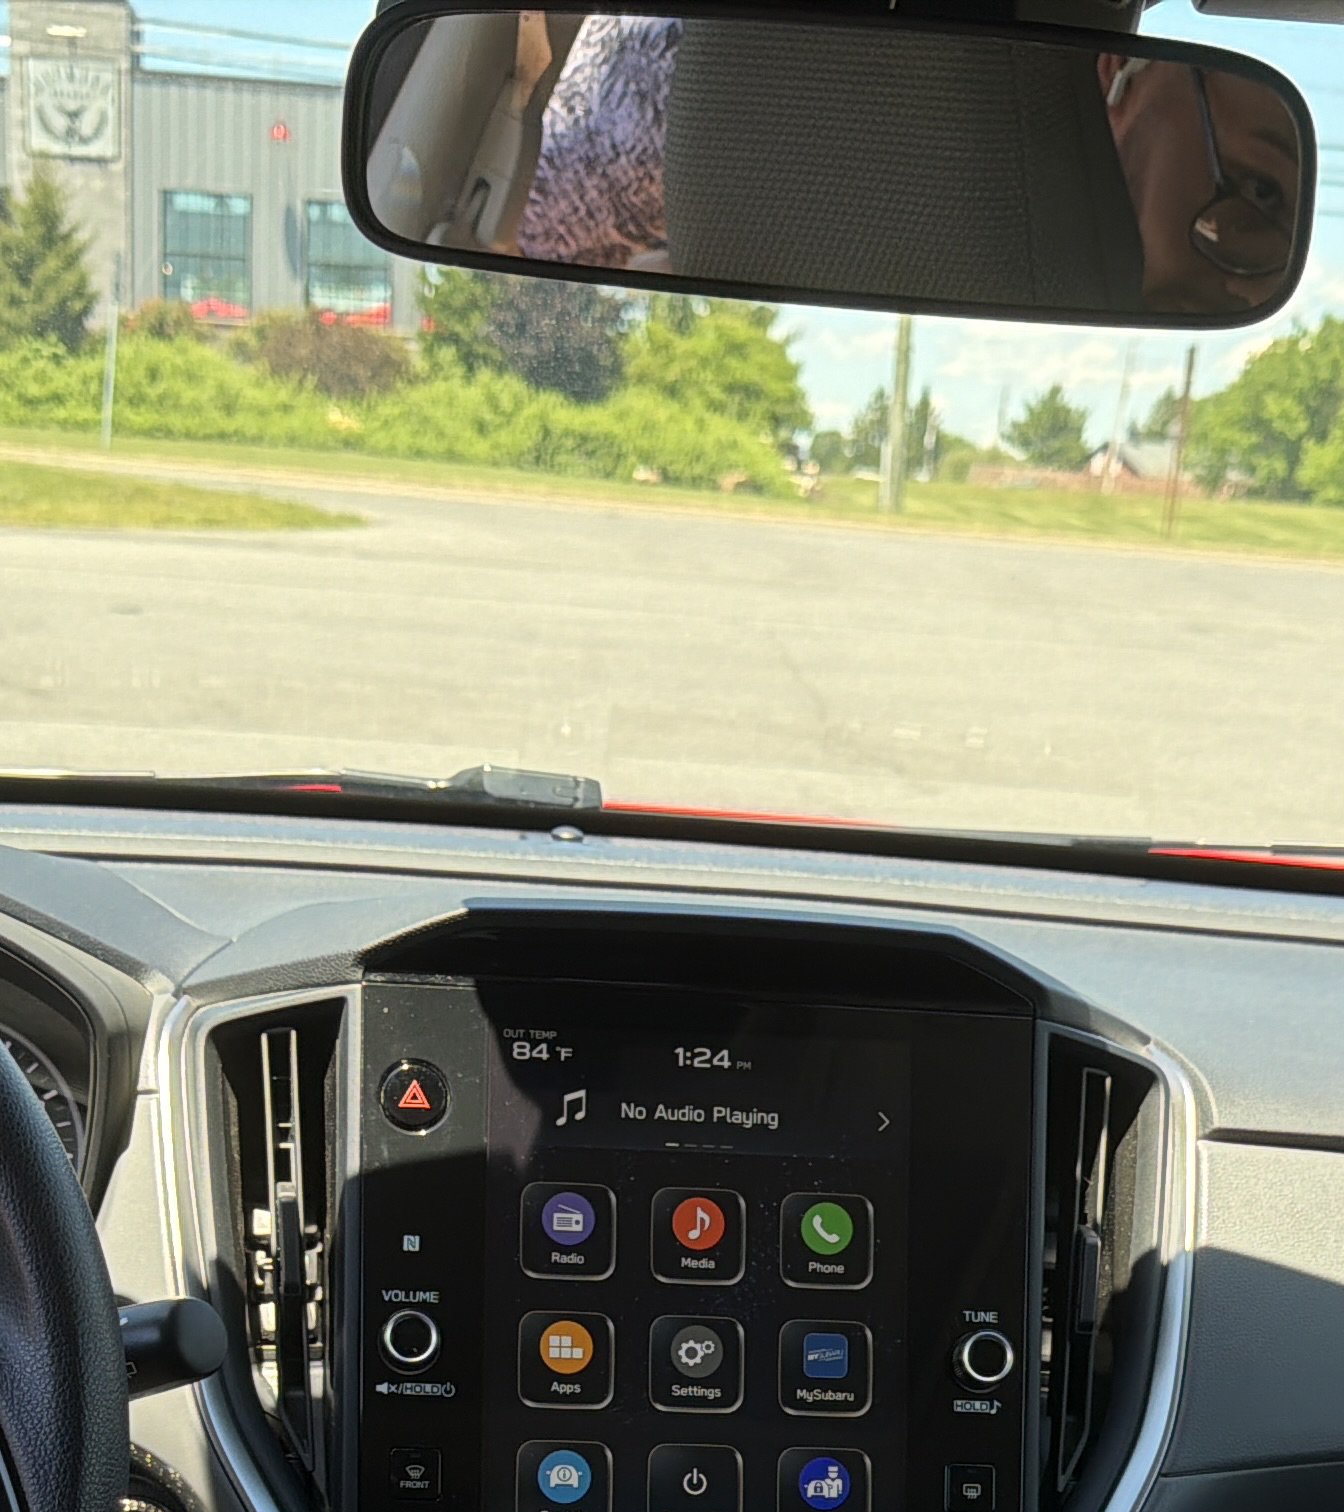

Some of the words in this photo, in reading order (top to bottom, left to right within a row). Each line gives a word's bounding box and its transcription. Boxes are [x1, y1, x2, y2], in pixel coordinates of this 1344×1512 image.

[503, 1029, 525, 1039] OUT
[529, 1030, 557, 1040] TEMP
[512, 1042, 550, 1061] 84
[674, 1047, 732, 1069] 1:24
[736, 1061, 752, 1070] PM
[621, 1103, 647, 1120] No
[654, 1104, 705, 1123] Audio
[713, 1107, 779, 1130] Playing
[551, 1252, 585, 1265] Radio
[681, 1257, 716, 1270] Media
[808, 1262, 845, 1274] Phone
[382, 1289, 440, 1303] VOLUME
[963, 1310, 999, 1323] TUNE
[550, 1382, 582, 1395] Apps
[671, 1385, 722, 1400] Settings
[796, 1389, 854, 1403] MySubaru
[954, 1400, 990, 1412] HOLD
[399, 1480, 430, 1489] FRONT
